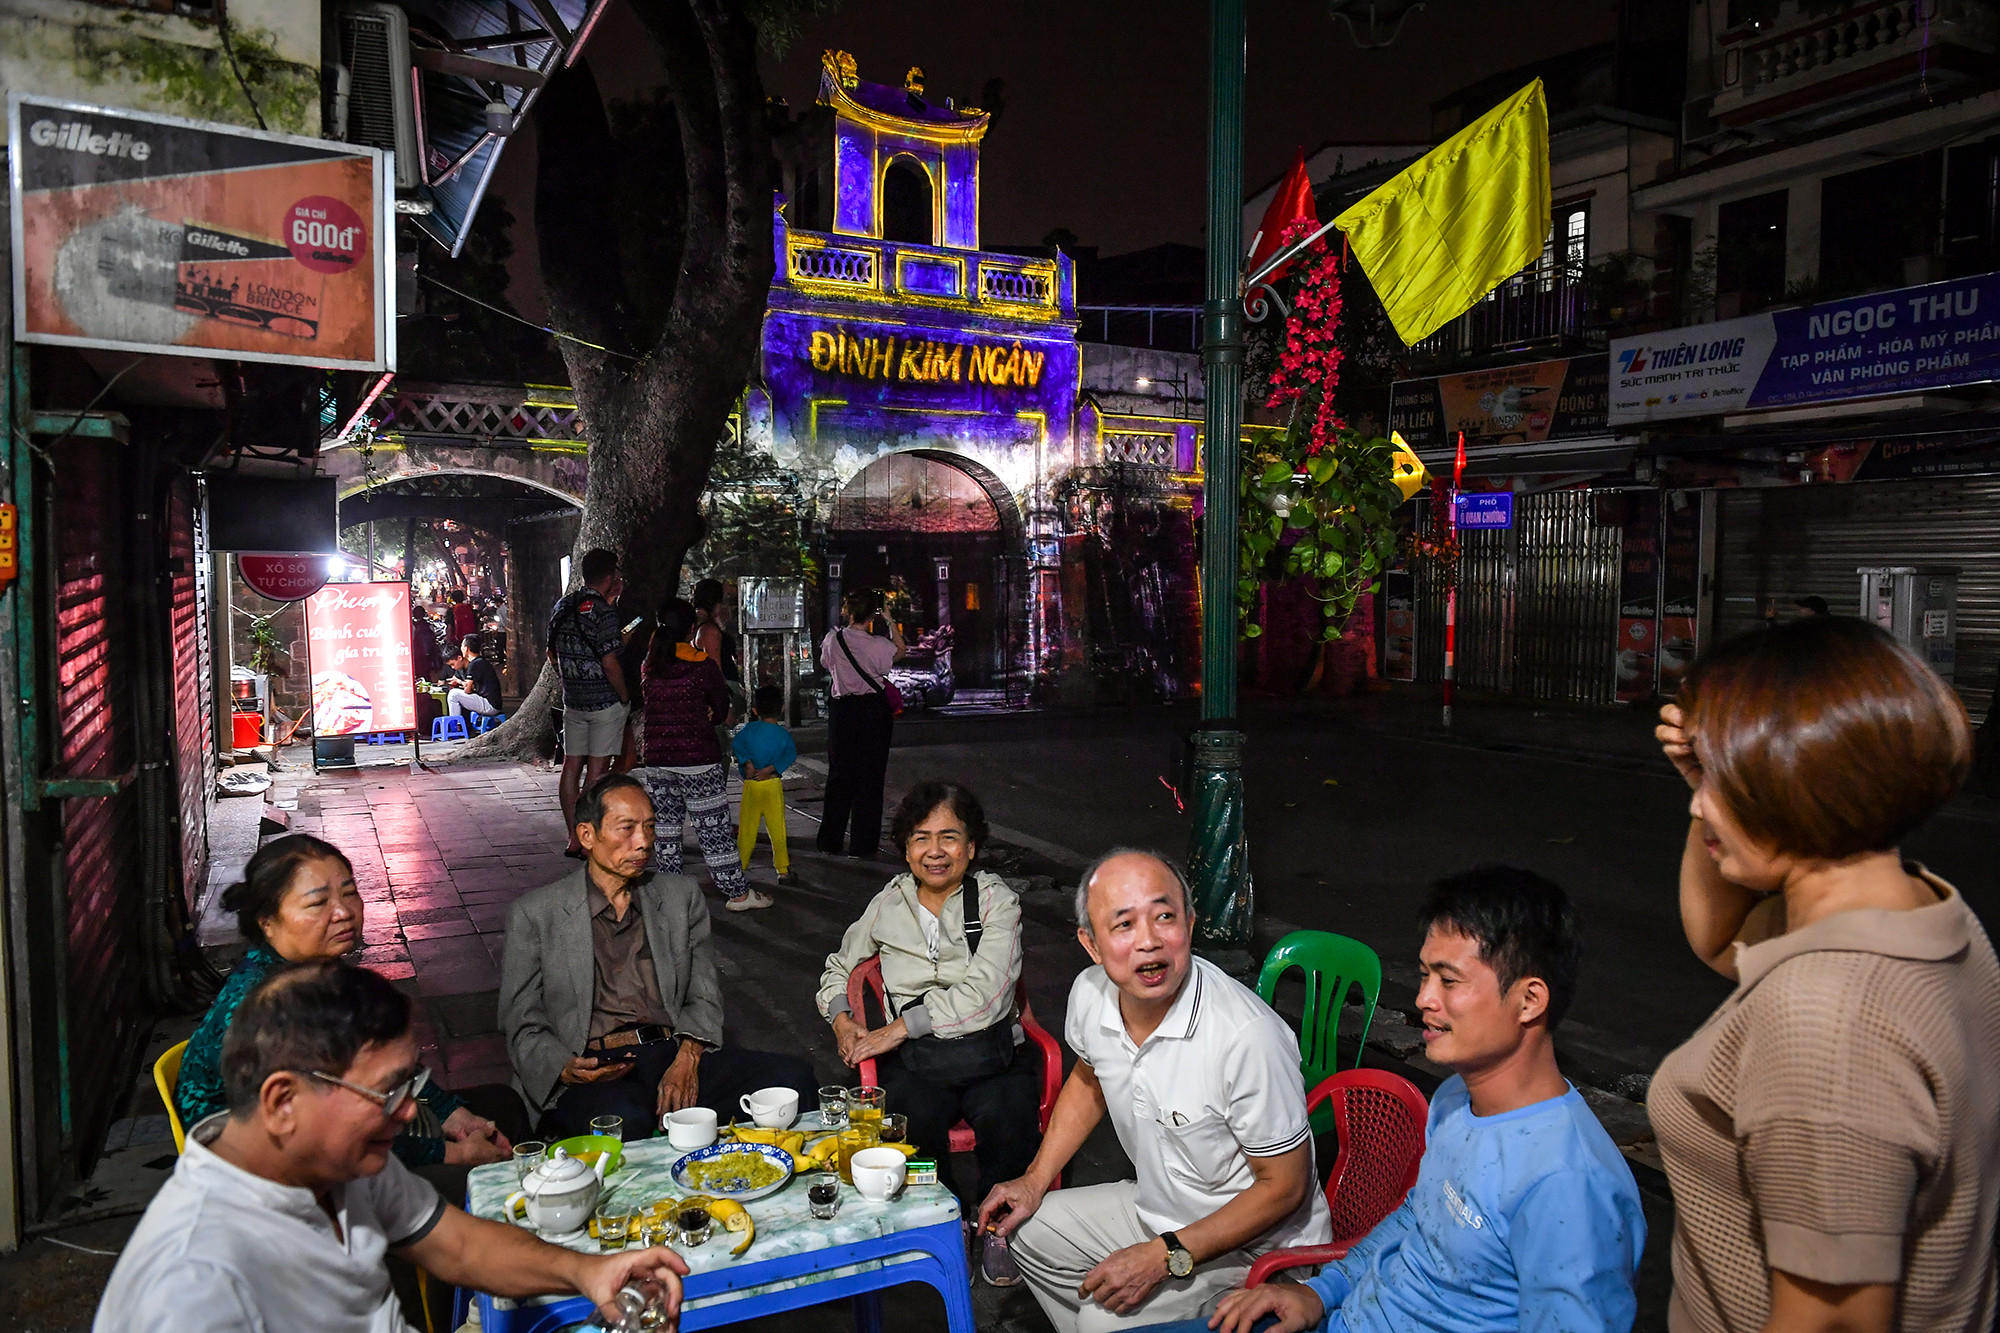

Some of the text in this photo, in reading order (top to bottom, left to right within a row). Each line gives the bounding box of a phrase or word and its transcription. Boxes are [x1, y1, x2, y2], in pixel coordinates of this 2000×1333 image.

[29, 118, 151, 161] Gillette
[186, 231, 249, 257] Gillette
[246, 294, 303, 315] BRIDGE
[248, 282, 318, 307] LONDON
[1807, 287, 1980, 340] NGỌC THU
[808, 323, 1045, 387] ĐÌNH KIM NGÂN
[1651, 337, 1746, 369] THIÊN LONG
[1780, 353, 1810, 371] TẠP
[1814, 341, 1862, 365] PHẨM
[1878, 336, 1914, 356] HÓA
[1920, 329, 1948, 350] MỸ
[1620, 376, 1642, 388] SỨC
[1645, 371, 1681, 384] MẠNH
[1707, 362, 1740, 376] THỨC
[1811, 349, 1970, 385] VĂN PHÒNG PHẨM
[1465, 511, 1482, 525] QUAN
[288, 560, 306, 574] SỐ
[258, 577, 316, 589] TỰ CHỌN
